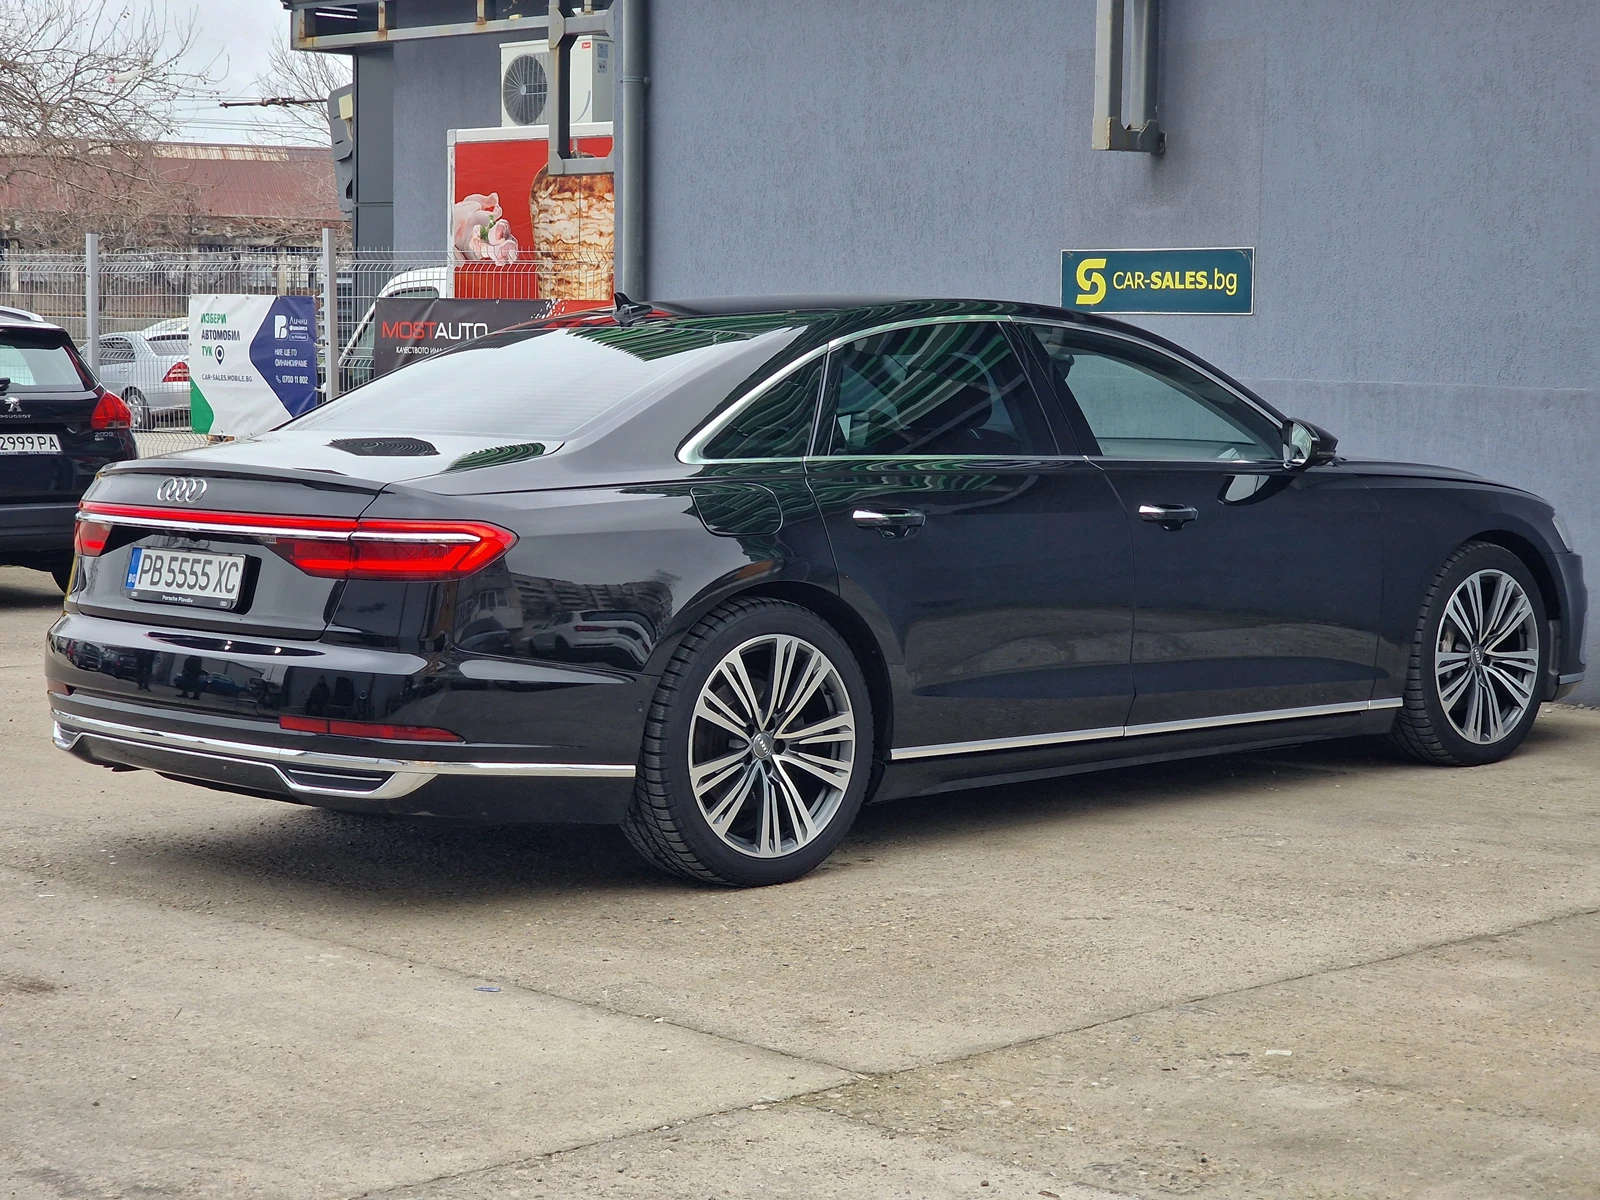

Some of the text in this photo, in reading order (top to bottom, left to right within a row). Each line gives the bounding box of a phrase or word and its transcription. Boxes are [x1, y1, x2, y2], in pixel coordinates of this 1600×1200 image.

[1112, 268, 1238, 296] CAR-SALES.bg
[200, 312, 227, 324] ИЗБЕРИ
[201, 329, 241, 341] АВТОМОБИЛ
[382, 321, 489, 340] MOSTAUTO
[201, 345, 213, 357] ТУК
[395, 346, 430, 355] КАЧЕСТВОТО
[274, 358, 308, 368] ФИНАНСИРАМЕ
[201, 373, 253, 383] CAR-SALES.MOBILE.BG
[0, 436, 59, 451] 2999 PA
[138, 553, 239, 594] PB 5555 XC
